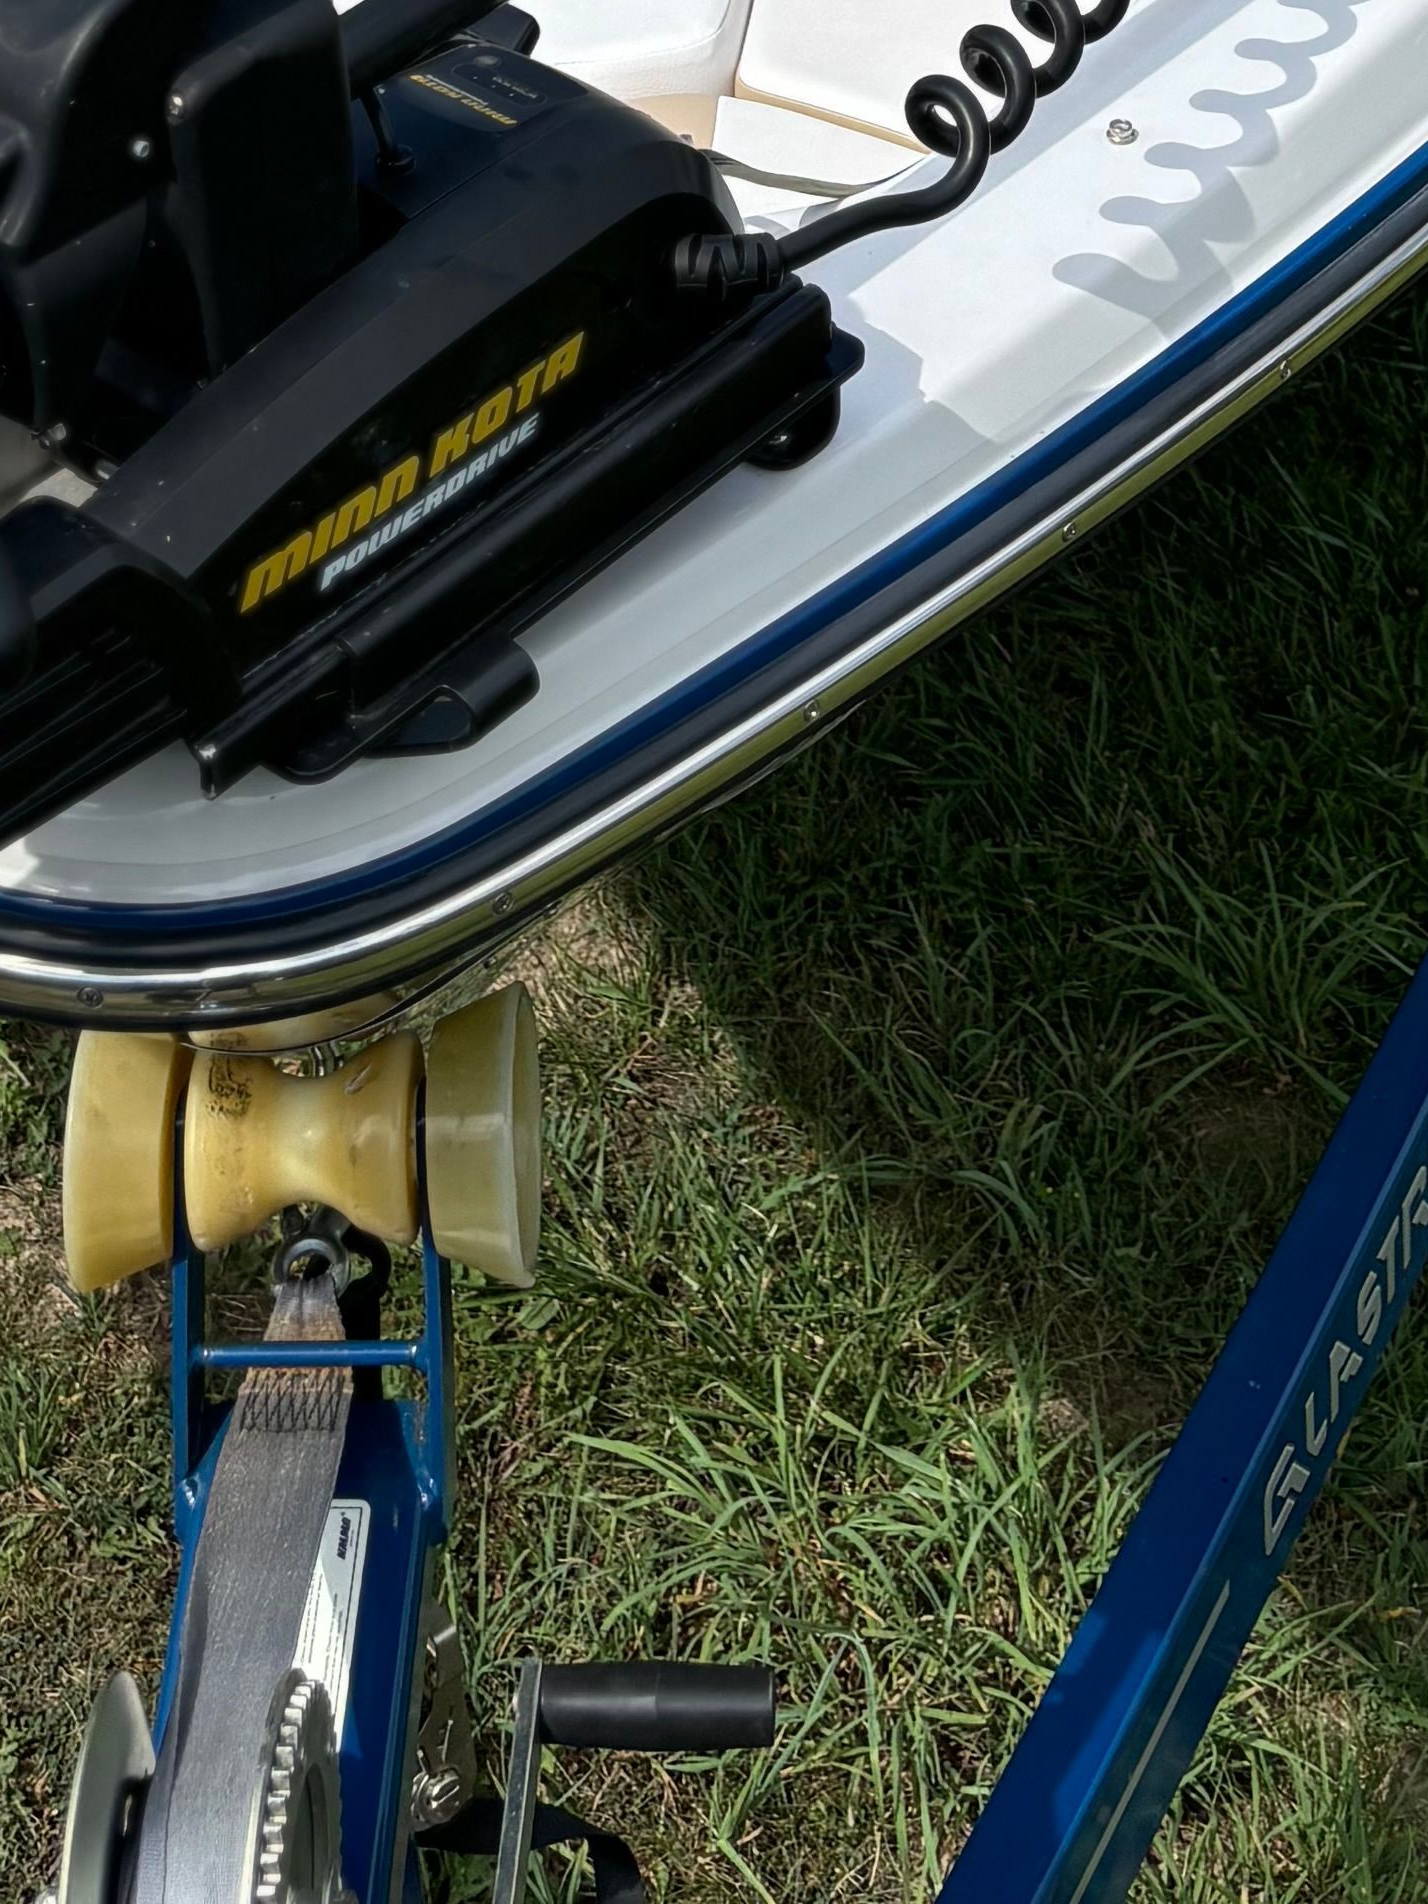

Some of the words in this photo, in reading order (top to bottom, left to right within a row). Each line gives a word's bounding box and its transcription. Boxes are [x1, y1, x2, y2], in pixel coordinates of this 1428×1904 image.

[239, 453, 419, 614] MINN
[430, 331, 585, 478] KOTA
[320, 413, 540, 592] POWERDRIVE
